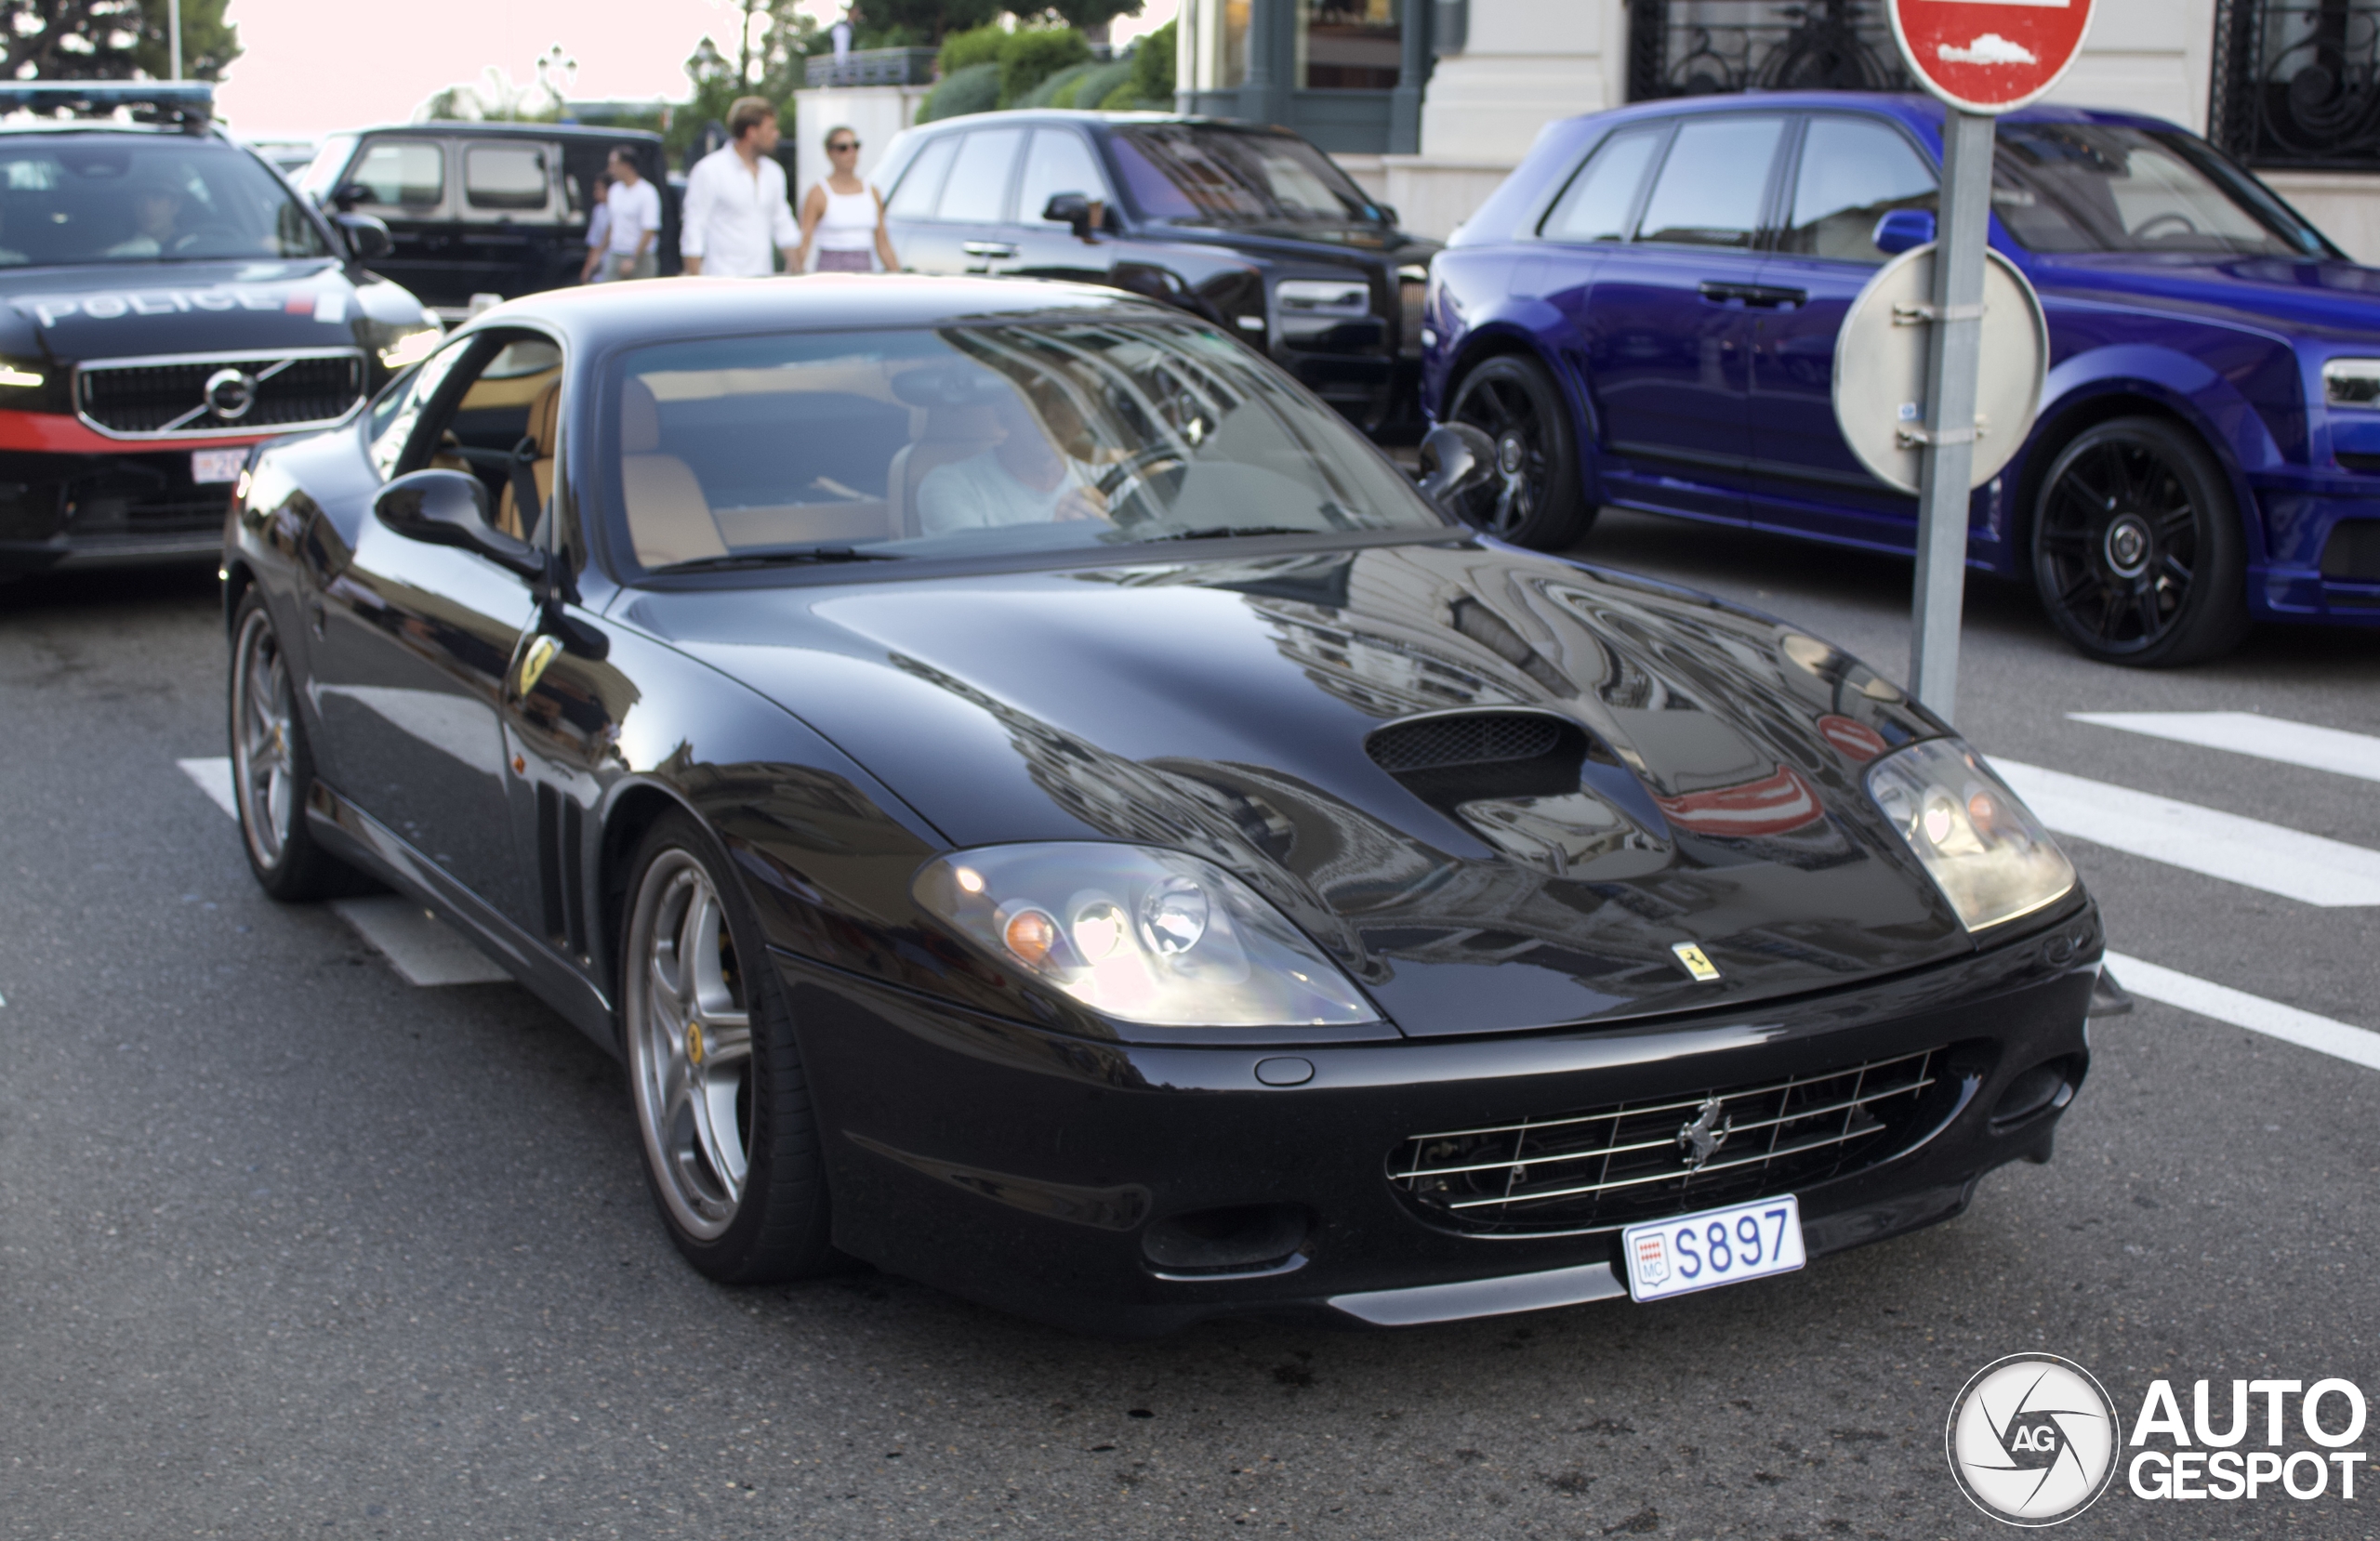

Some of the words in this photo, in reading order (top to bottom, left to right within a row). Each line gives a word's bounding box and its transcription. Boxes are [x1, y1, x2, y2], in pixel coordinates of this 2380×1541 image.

[35, 290, 281, 327] POLICE
[1676, 1208, 1787, 1278] S897
[1643, 1261, 1663, 1278] MC
